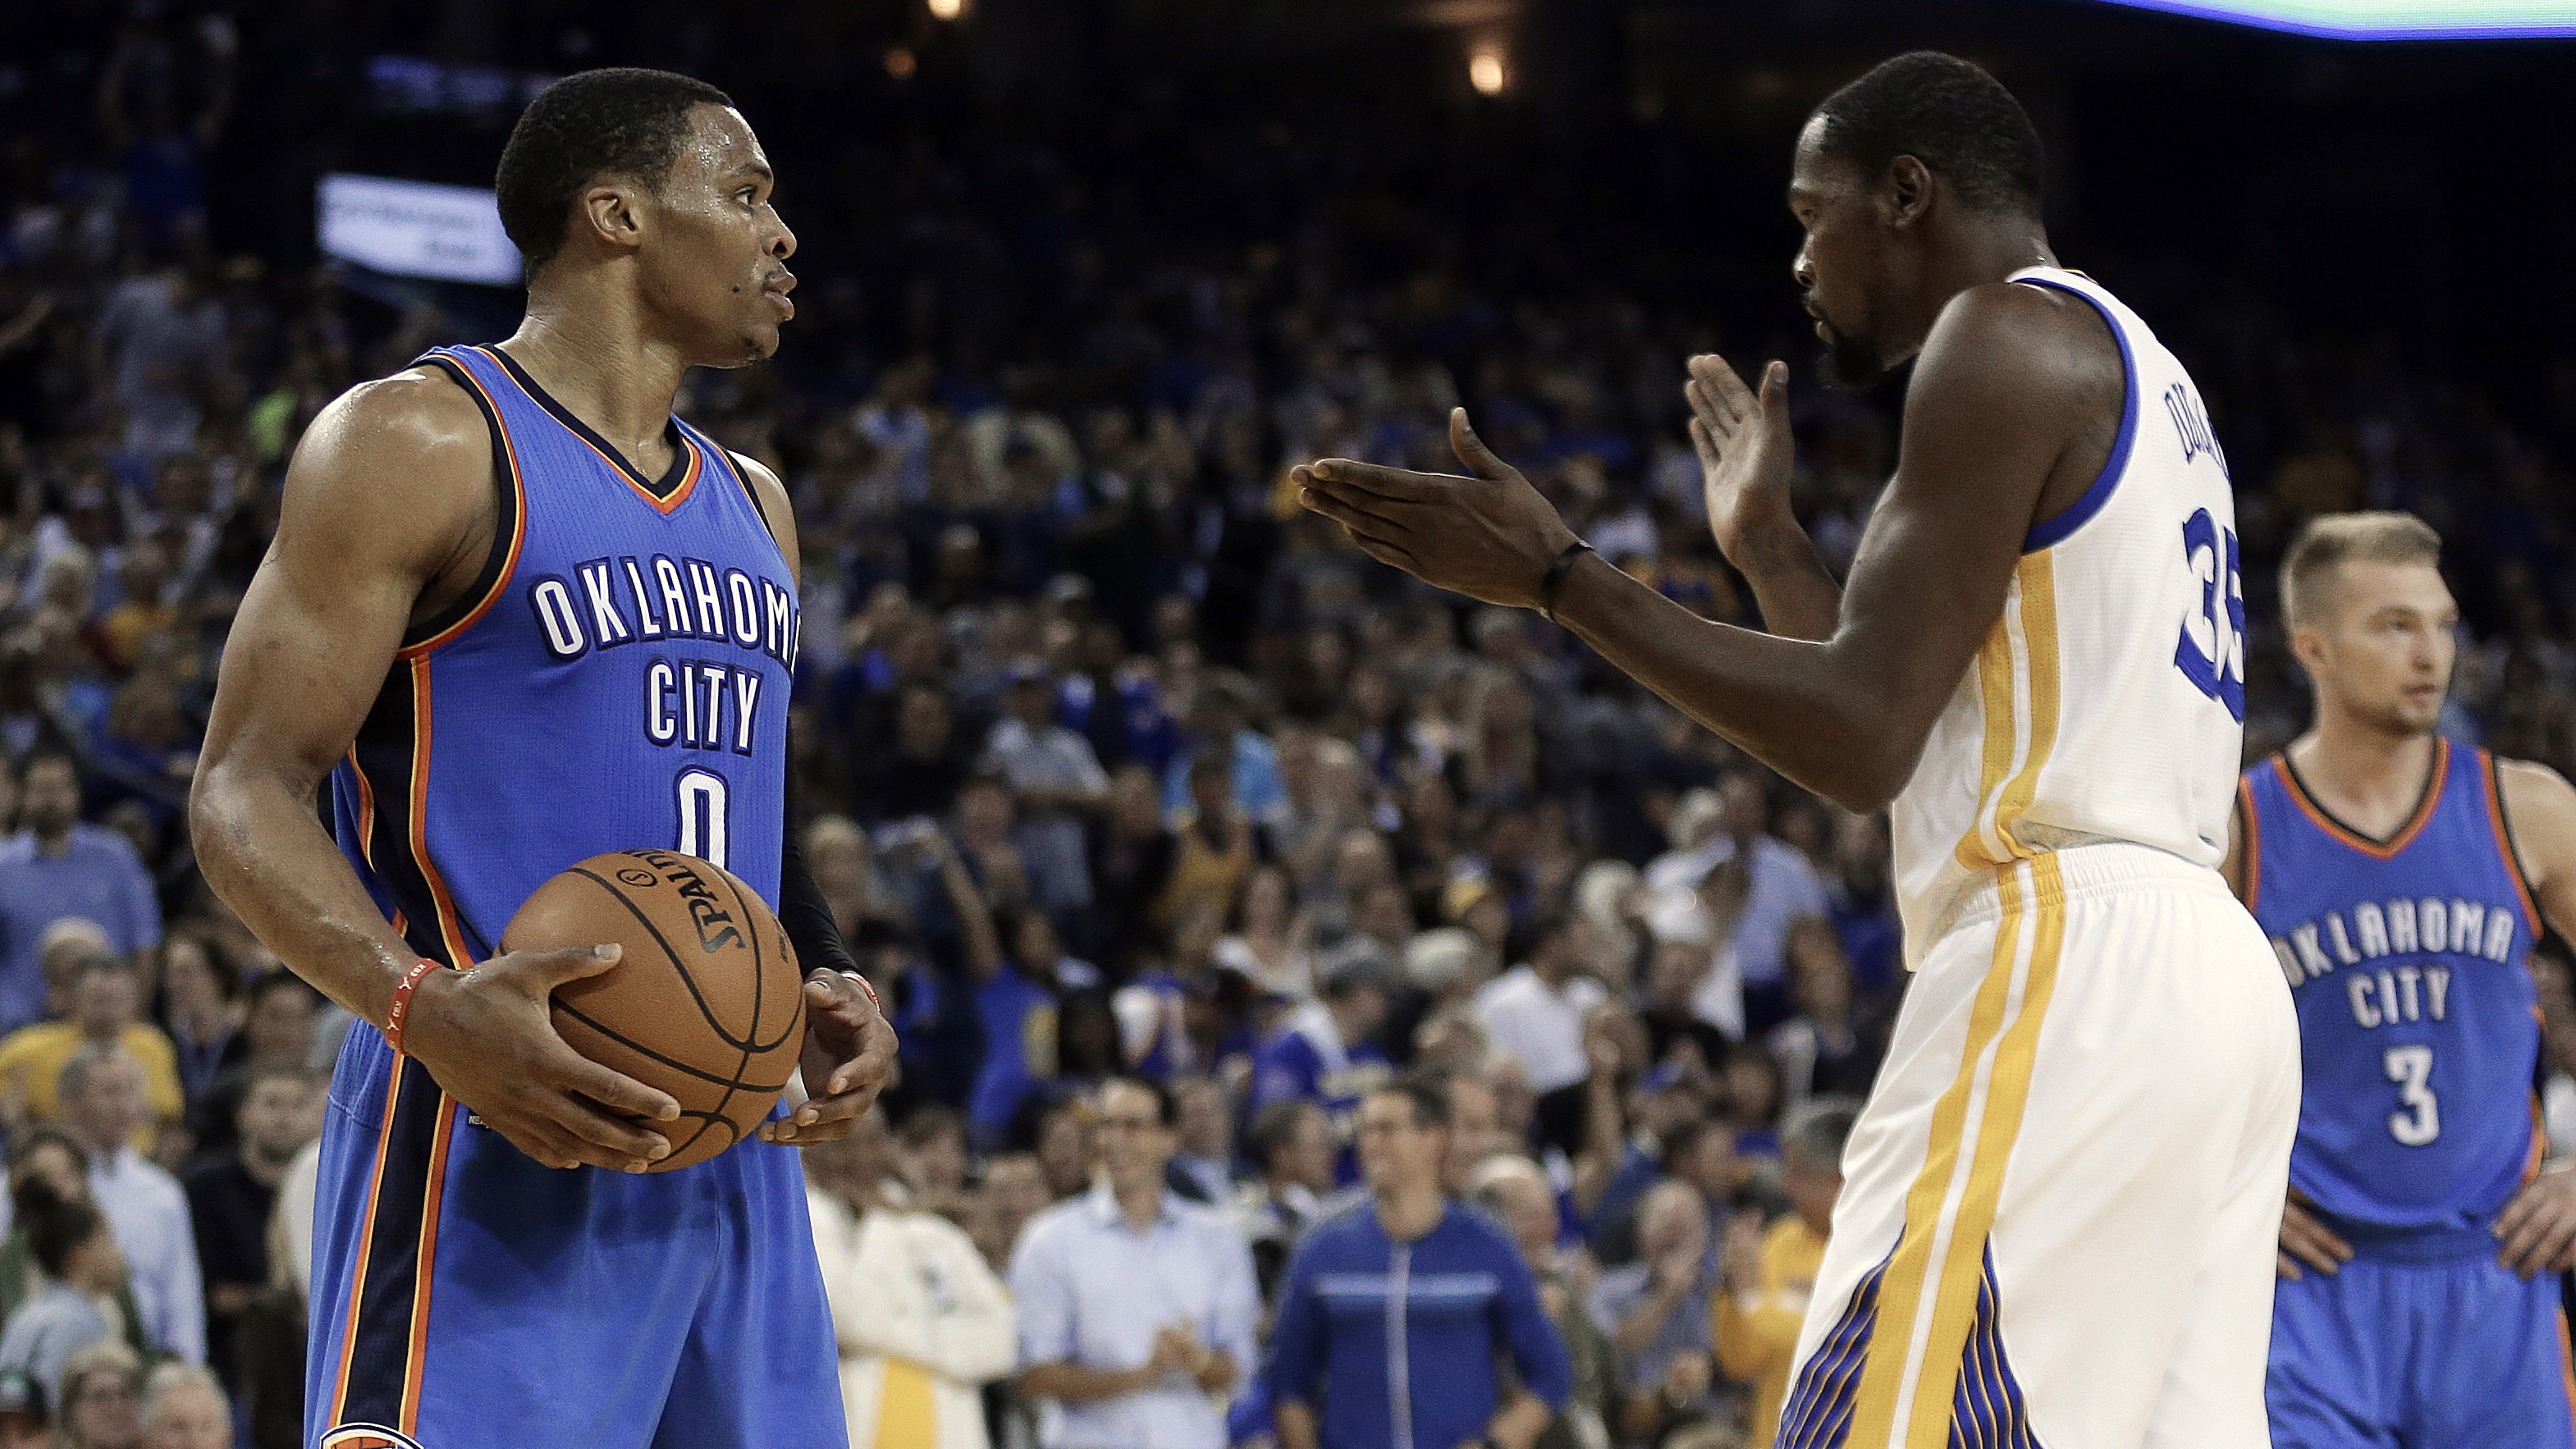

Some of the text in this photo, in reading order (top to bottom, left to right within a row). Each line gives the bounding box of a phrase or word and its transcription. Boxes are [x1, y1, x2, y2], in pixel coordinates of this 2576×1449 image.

[2174, 507, 2245, 725] 35
[644, 659, 763, 756] CITY
[674, 765, 730, 871] 0
[2270, 896, 2514, 988] OKLAHOMA
[2345, 963, 2451, 1028] CITY
[2382, 1043, 2441, 1146] 3
